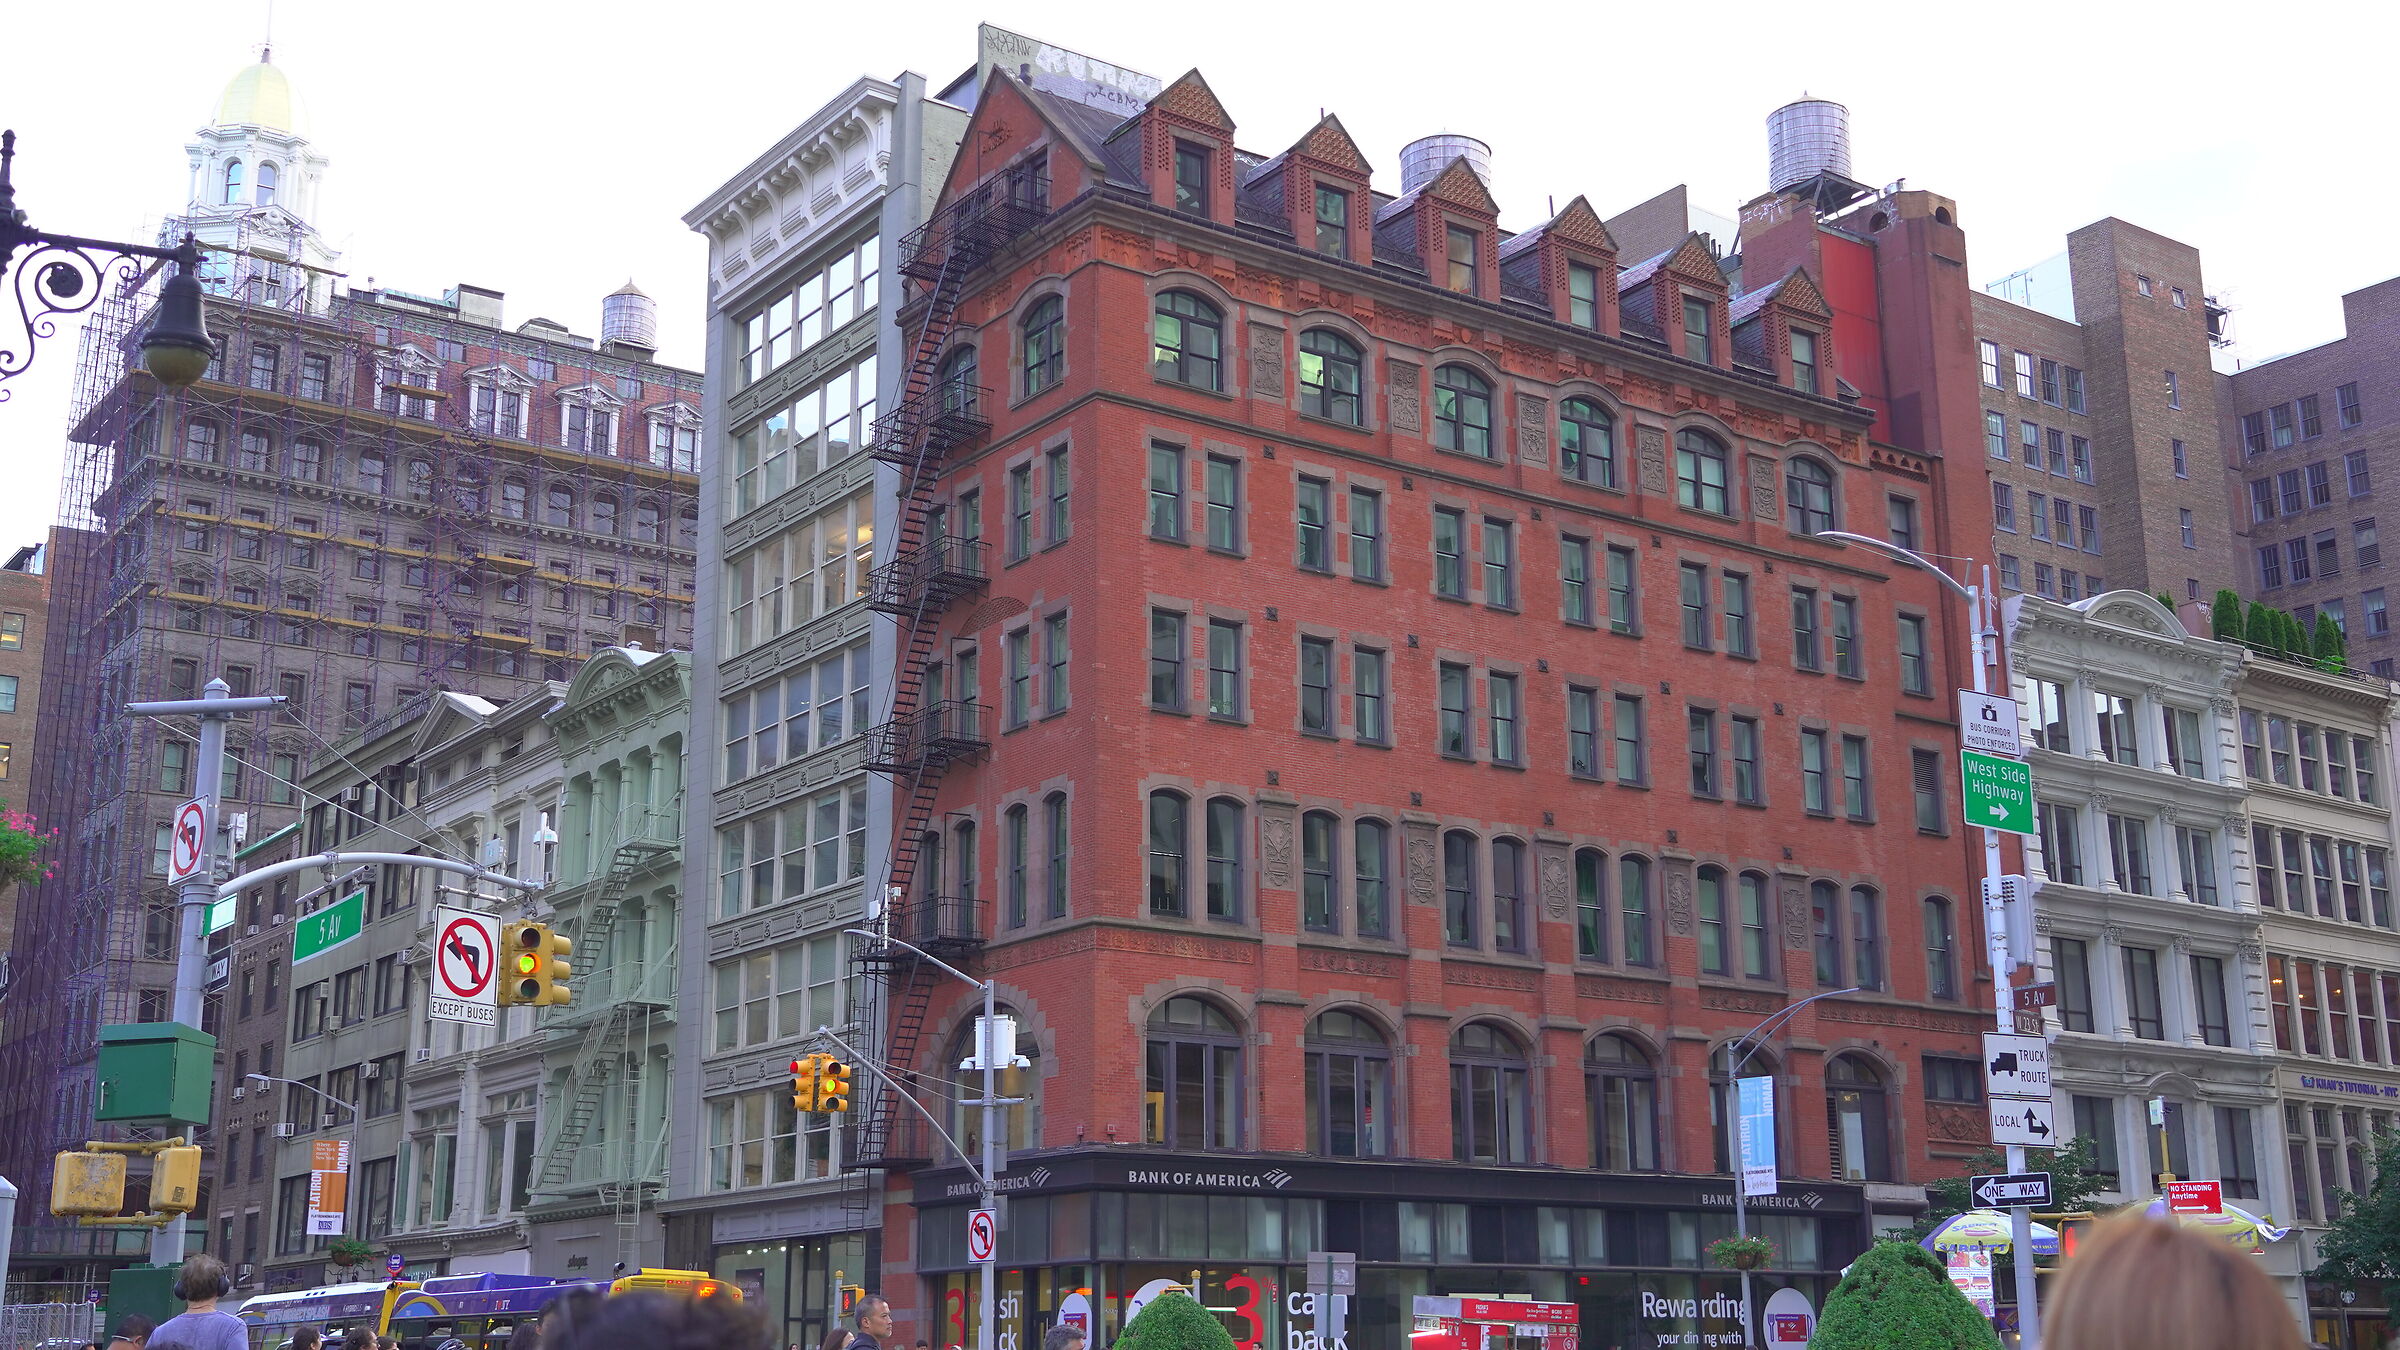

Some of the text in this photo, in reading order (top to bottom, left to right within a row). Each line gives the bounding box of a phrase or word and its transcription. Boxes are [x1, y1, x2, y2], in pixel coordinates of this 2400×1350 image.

[1969, 722, 2011, 737] BUS CORRIDOR
[1967, 734, 2016, 751] PHOTO ENFORCED
[1967, 759, 2026, 784] West Side
[1972, 778, 2024, 806] Highway
[318, 913, 342, 945] 5 Av
[211, 960, 226, 981] WAY
[2024, 991, 2030, 1006] 5
[432, 1001, 494, 1021] EXCEPT BUSES
[2015, 1015, 2022, 1029] W
[2023, 1016, 2031, 1031] 23
[2018, 1049, 2046, 1062] TRUCK
[2020, 1070, 2047, 1083] ROUTE
[1761, 1077, 1774, 1116] NOMAD
[2316, 1077, 2344, 1092] KHAN'S
[2344, 1081, 2379, 1096] TUTORIAL
[2384, 1086, 2399, 1098] NYC
[1994, 1115, 2021, 1128] LOCAL
[1740, 1115, 1752, 1166] FLATIRON
[337, 1140, 349, 1172] NOMAD
[947, 1182, 972, 1197] BANK
[993, 1175, 1030, 1191] MERICA
[1128, 1170, 1261, 1188] BANK OF AMERICA
[2181, 1184, 2212, 1192] STANDING
[308, 1170, 322, 1212] FLATIRON
[1984, 1183, 2041, 1198] ONE WAY
[2171, 1192, 2198, 1200] Anytime
[1702, 1194, 1733, 1206] BANK
[1751, 1196, 1800, 1208] AMERICA
[1657, 1332, 1680, 1348] your
[1719, 1330, 1742, 1344] with
